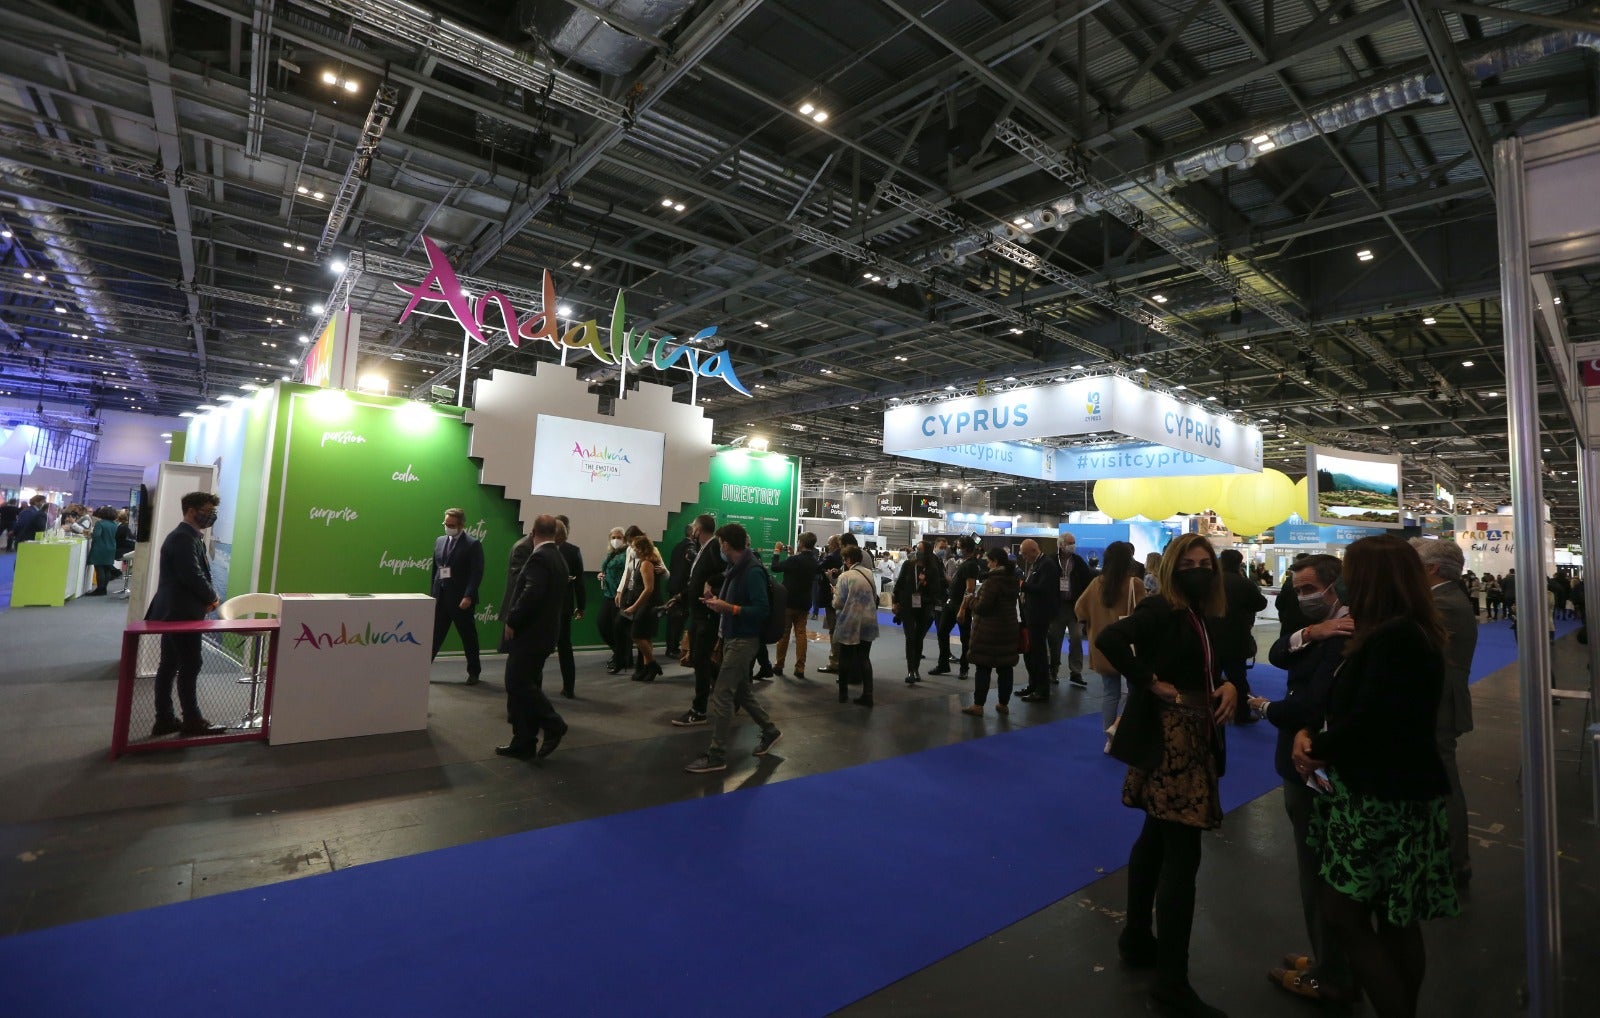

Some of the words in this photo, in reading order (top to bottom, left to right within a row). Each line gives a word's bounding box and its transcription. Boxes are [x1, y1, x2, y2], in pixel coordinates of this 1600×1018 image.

[394, 234, 753, 397] Andalucía
[921, 403, 1029, 437] CYPRUS
[1164, 411, 1221, 448] CYPRUS
[321, 430, 366, 447] passion
[571, 441, 631, 464] Andalucía
[392, 464, 420, 482] calm
[596, 464, 618, 473] EMOTION
[722, 483, 781, 506] DIRECTORY
[309, 507, 358, 526] surprise
[463, 519, 487, 543] iety
[1462, 529, 1515, 541] CROATI
[1471, 543, 1488, 551] Full
[1490, 543, 1500, 553] of
[1504, 543, 1515, 554] lif
[379, 551, 433, 575] happiness
[293, 620, 421, 650] Andalucía
